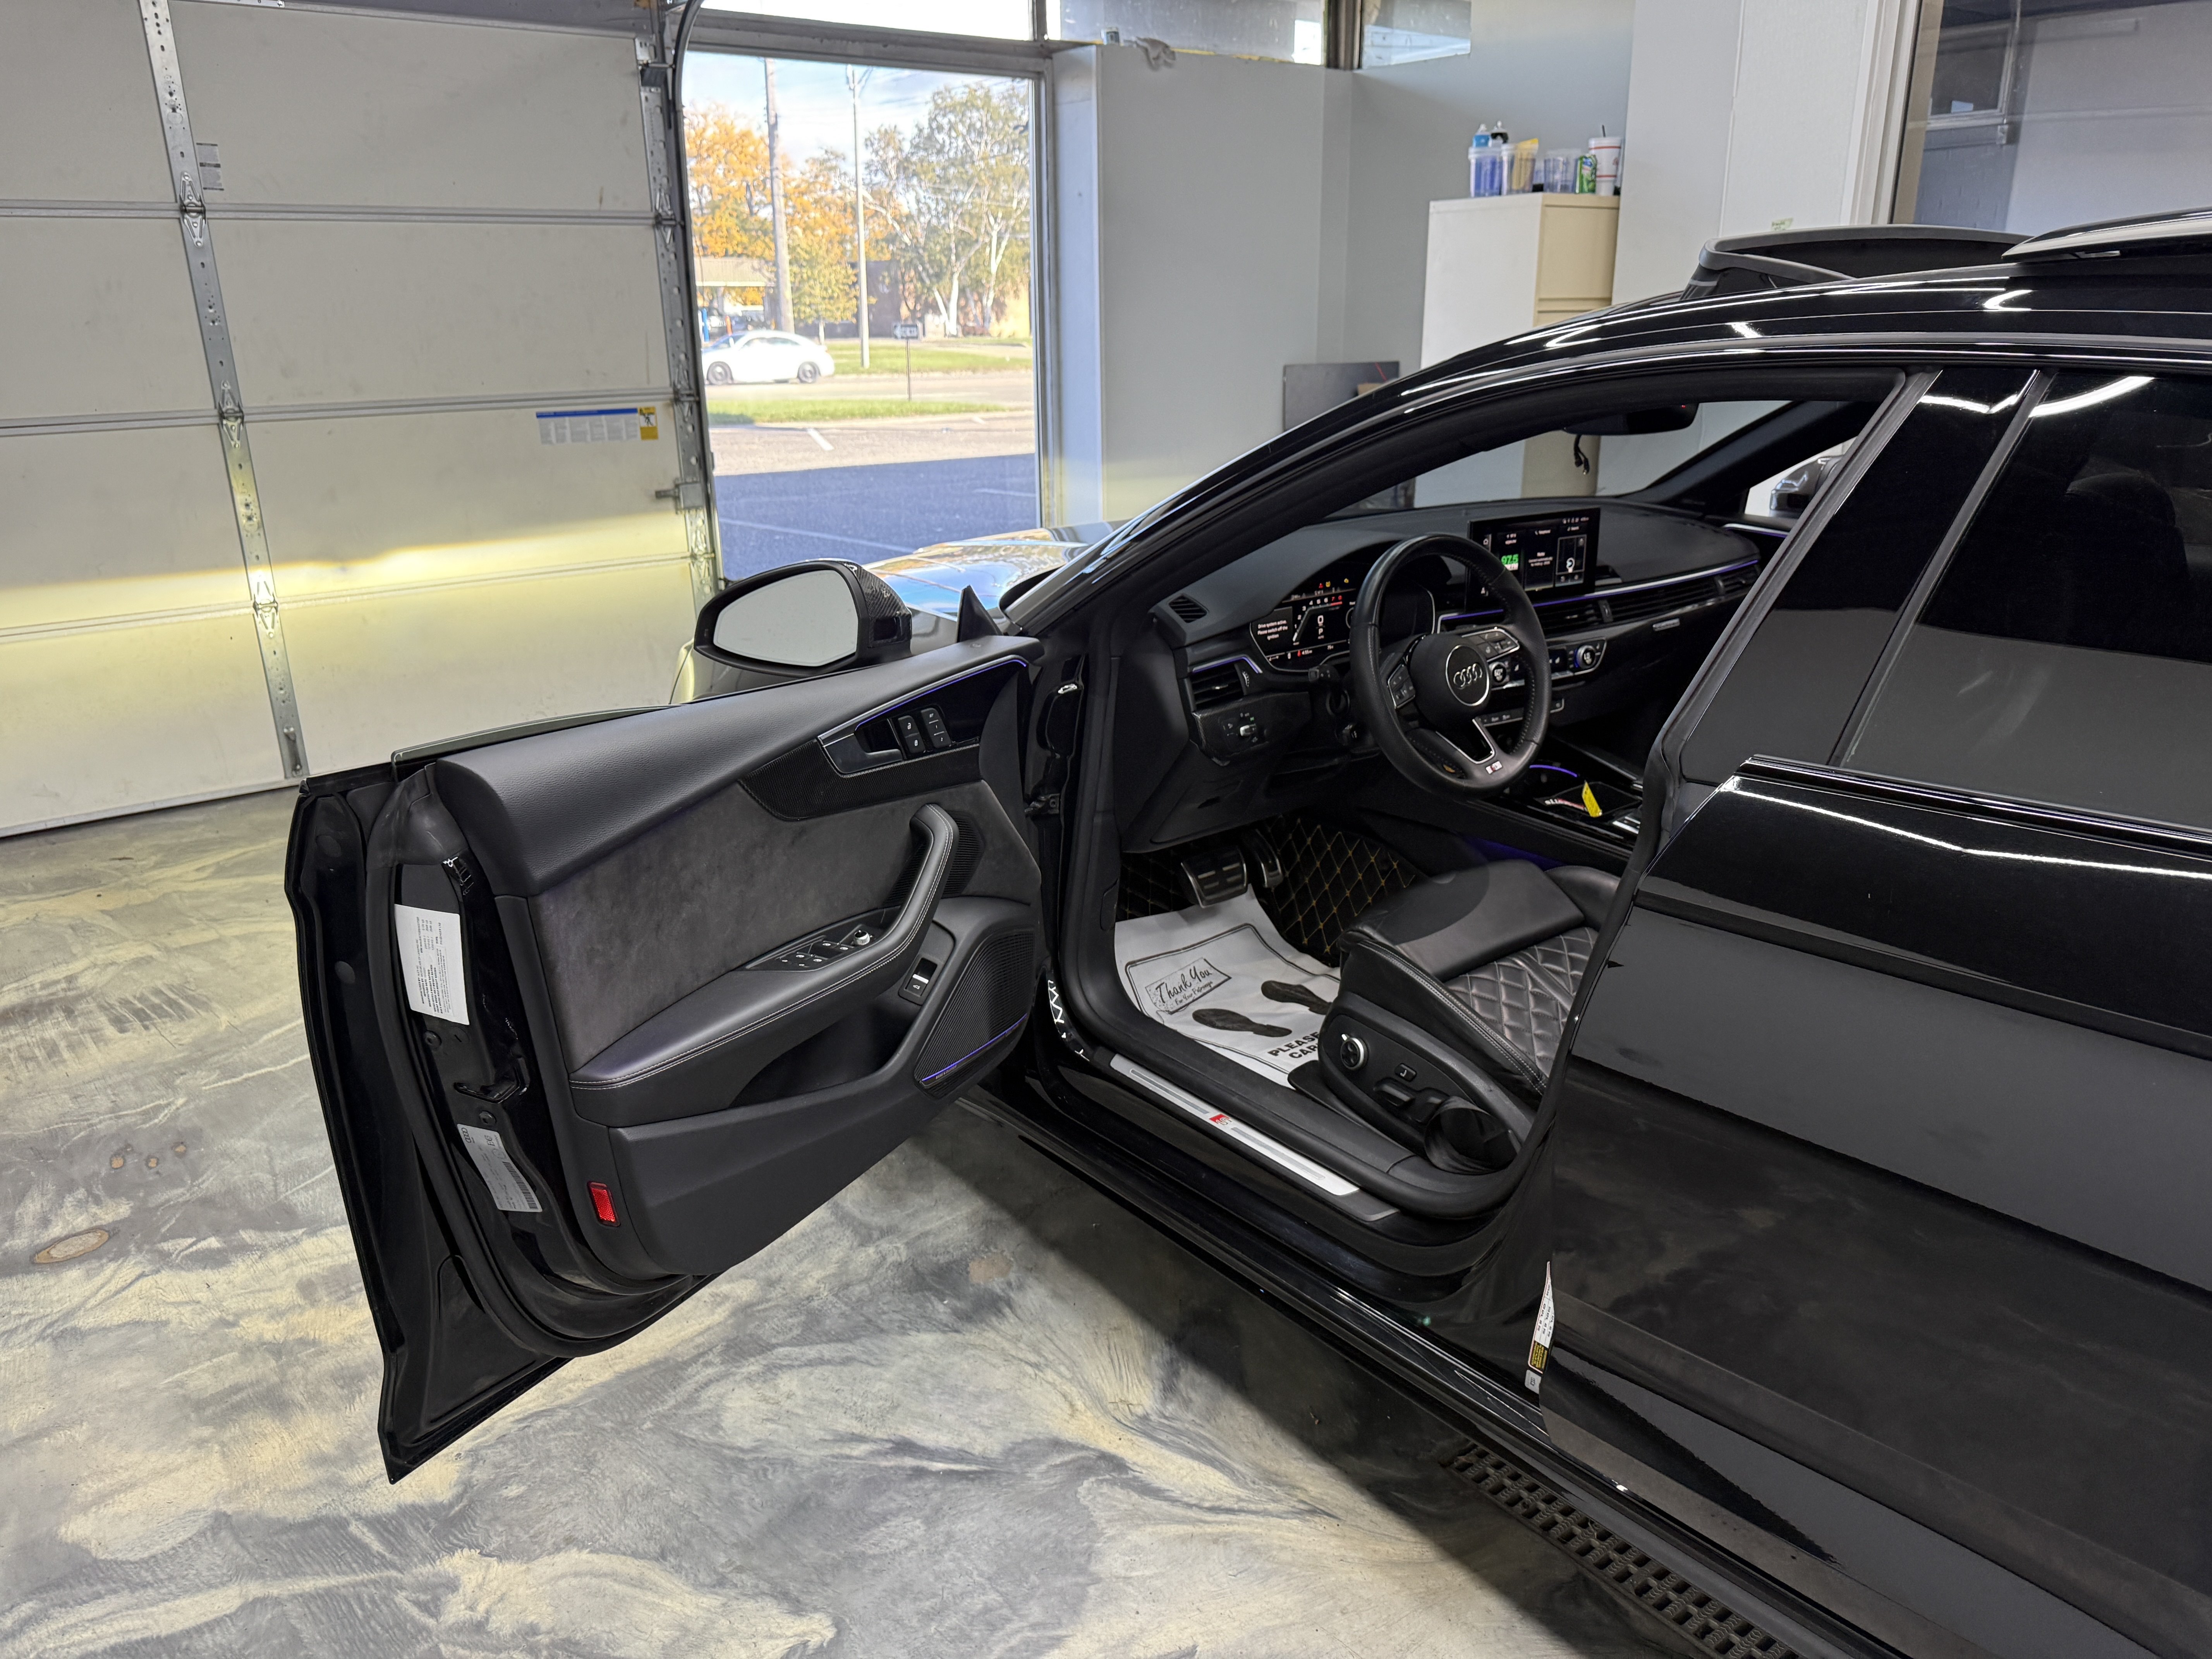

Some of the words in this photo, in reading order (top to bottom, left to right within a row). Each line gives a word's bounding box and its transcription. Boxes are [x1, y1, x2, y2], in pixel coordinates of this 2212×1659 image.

[1155, 974, 1192, 1003] Thank
[1190, 966, 1213, 986] You
[1183, 993, 1194, 1003] Your
